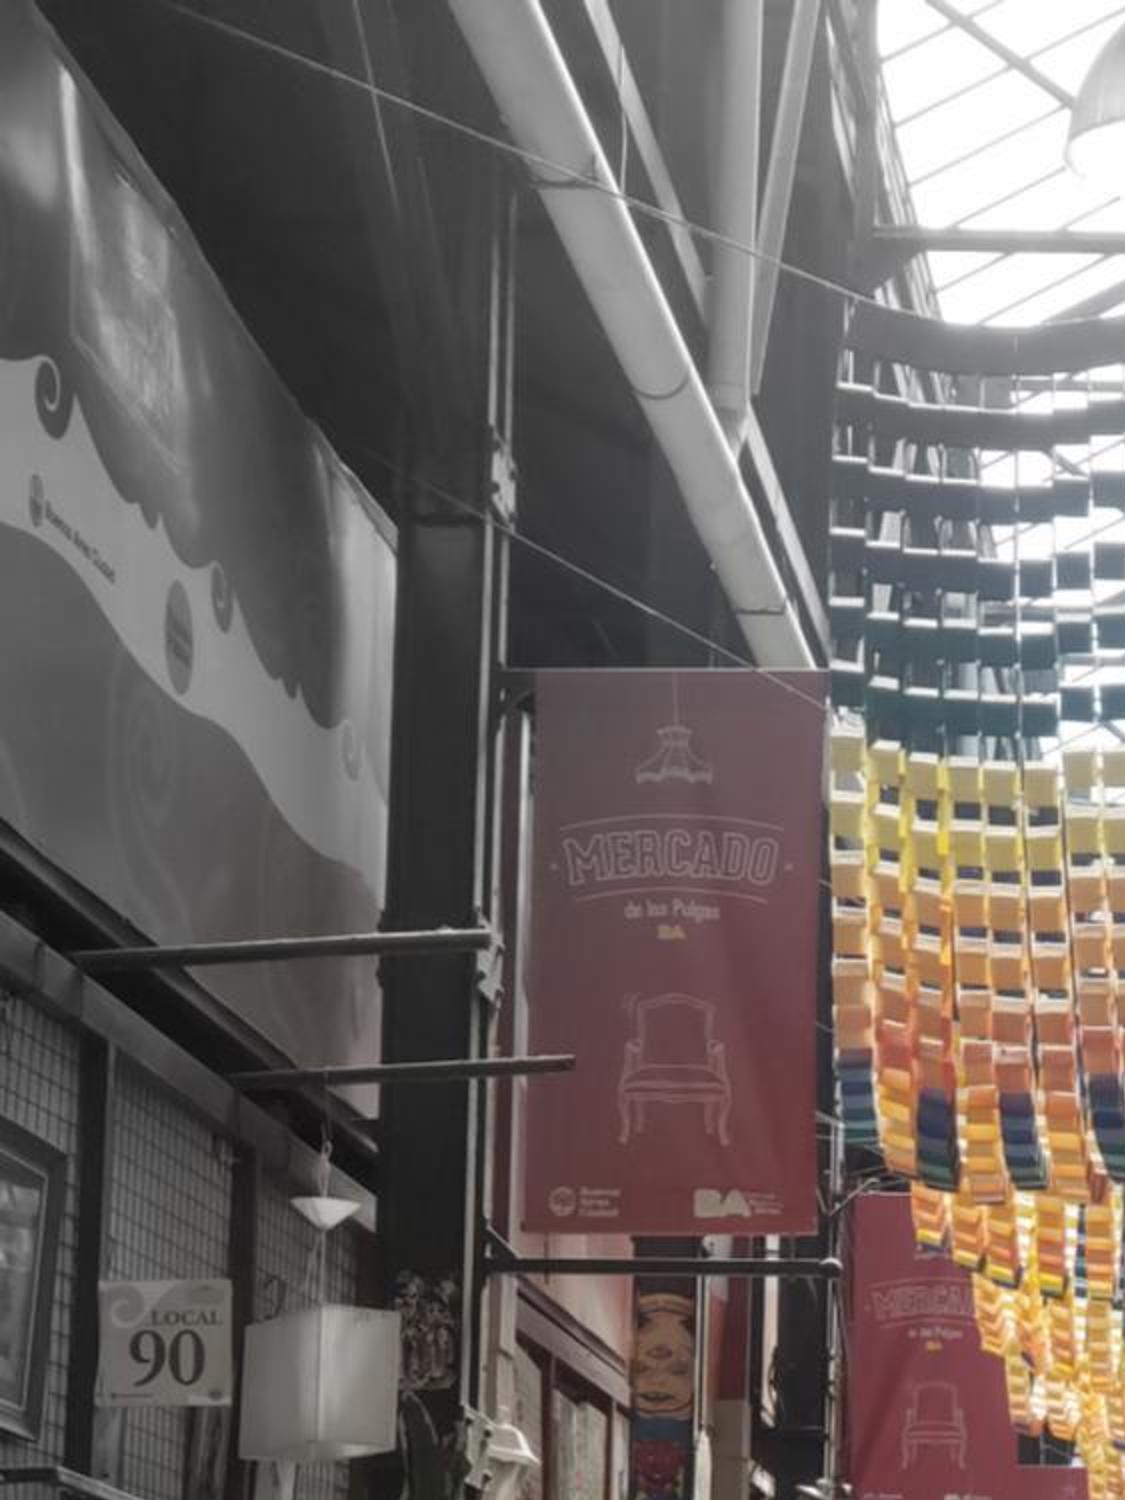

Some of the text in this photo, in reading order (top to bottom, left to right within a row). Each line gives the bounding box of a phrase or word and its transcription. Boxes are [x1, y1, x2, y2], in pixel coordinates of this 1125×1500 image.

[562, 828, 779, 886] MERCADO
[693, 1189, 751, 1217] BA
[150, 1309, 223, 1326] LOCAL
[128, 1328, 206, 1388] 90
